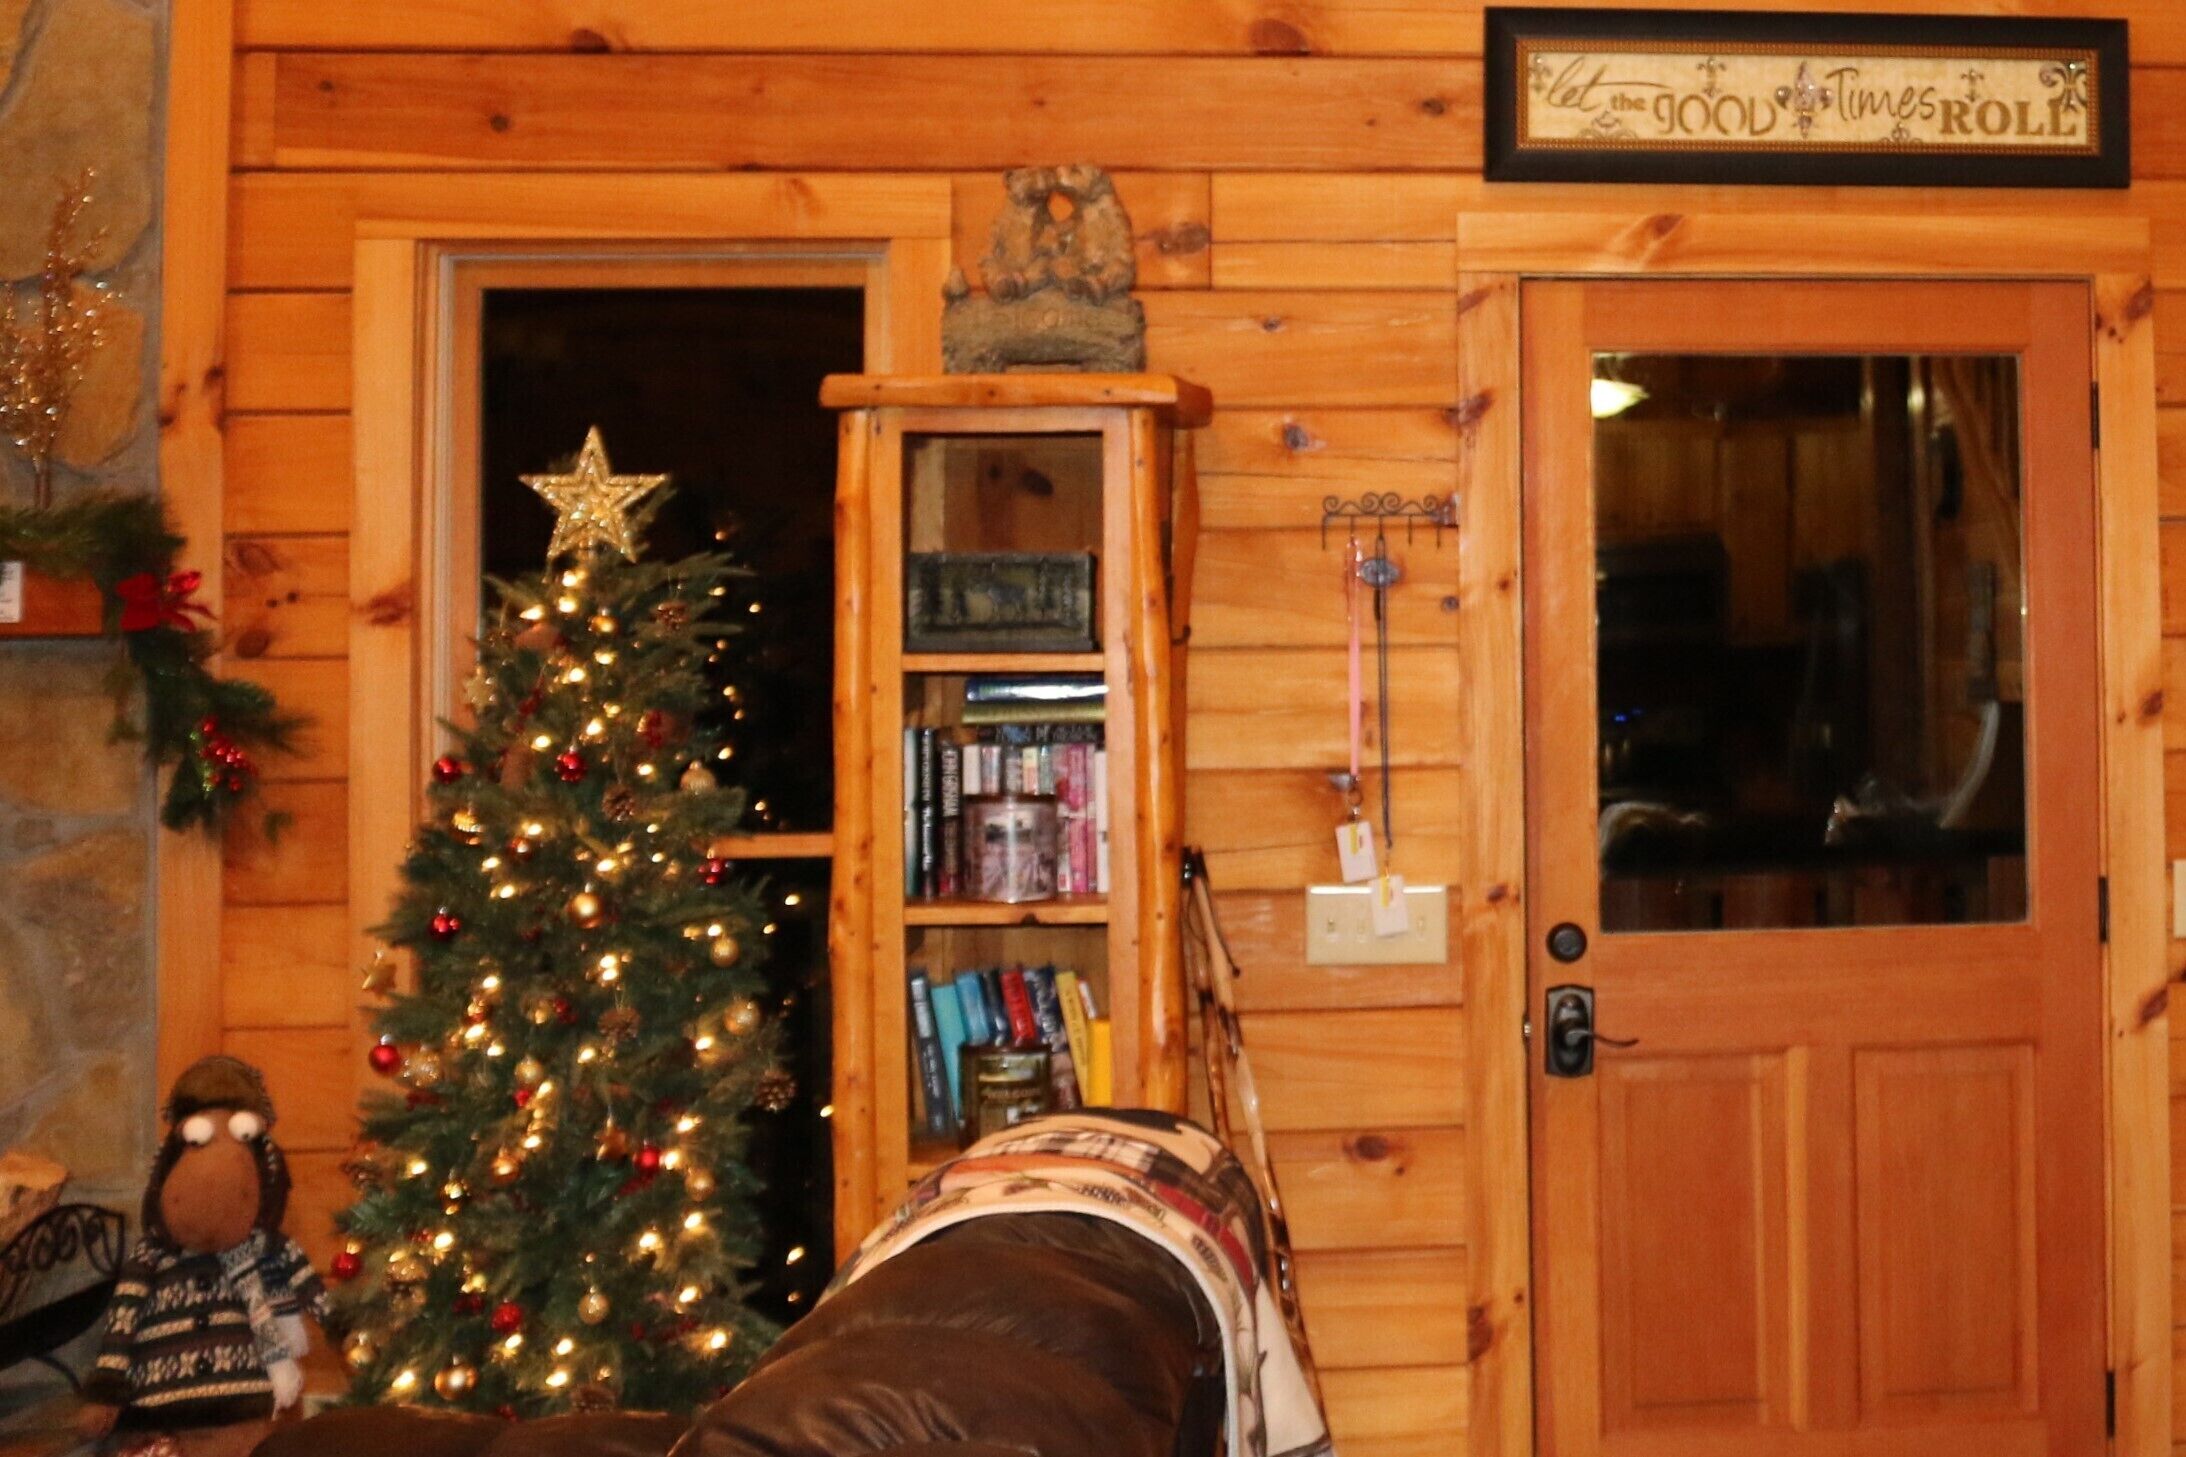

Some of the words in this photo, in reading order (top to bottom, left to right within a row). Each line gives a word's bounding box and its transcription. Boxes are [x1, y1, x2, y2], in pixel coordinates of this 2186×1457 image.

[1547, 56, 1672, 112] let
[1610, 92, 1647, 112] the
[1825, 66, 1936, 122] Times
[1938, 98, 2077, 137] ROLL
